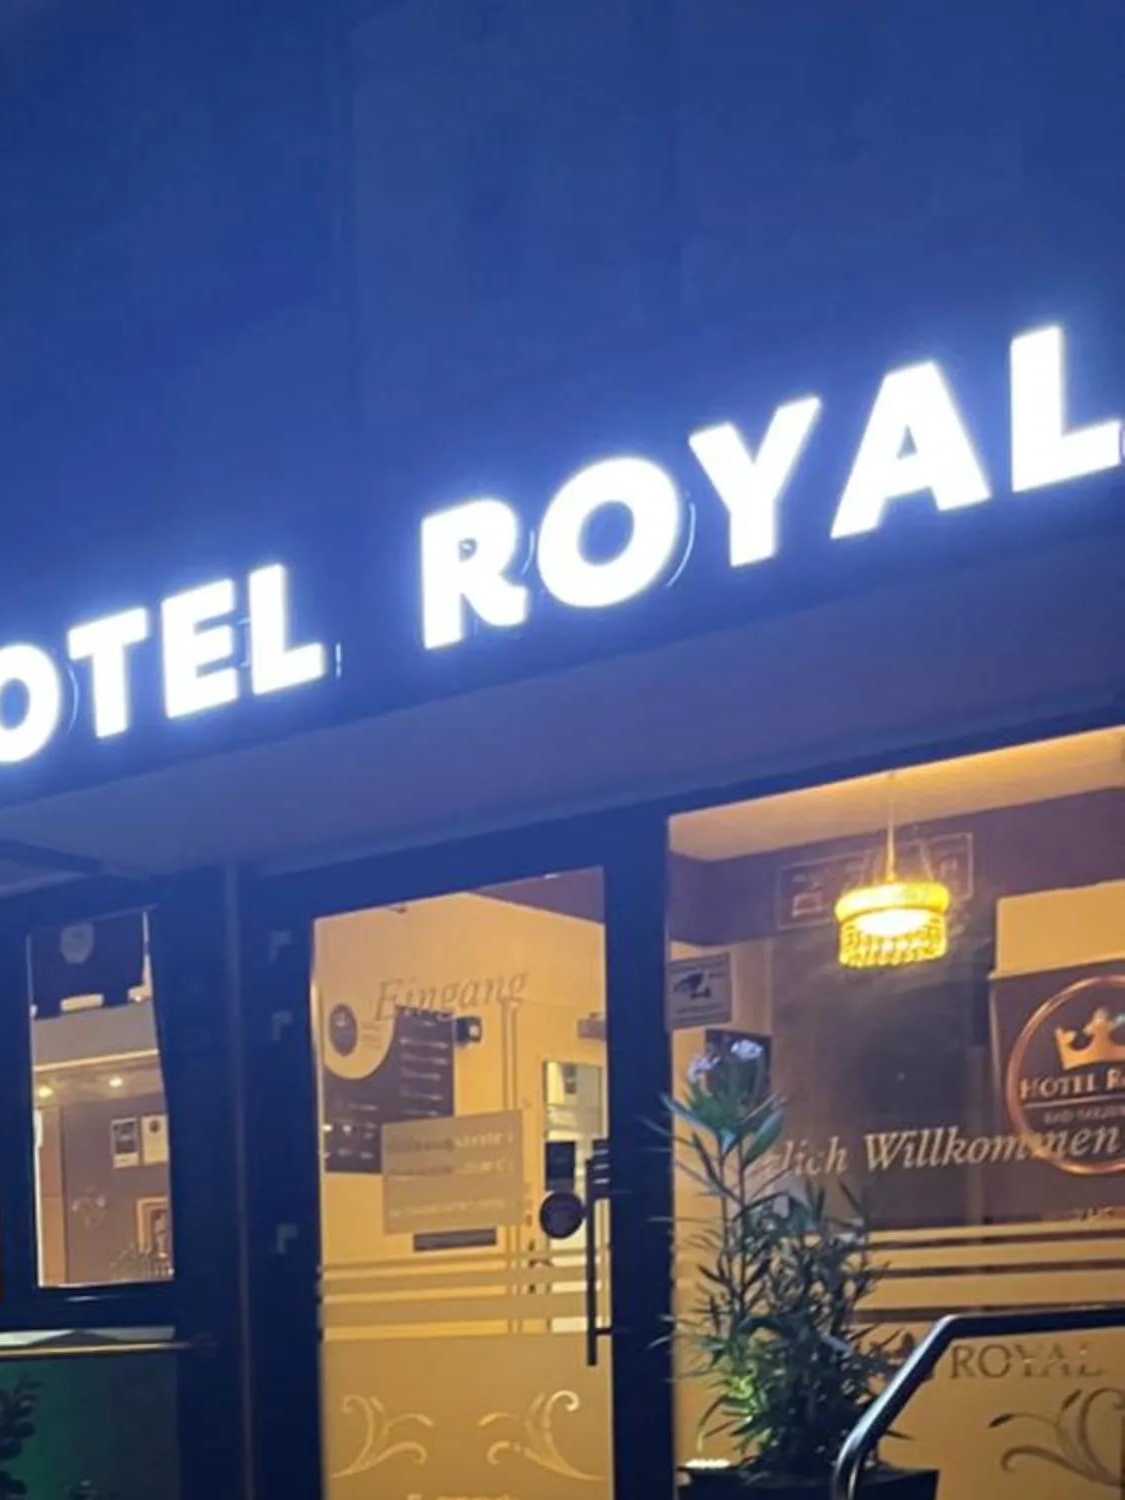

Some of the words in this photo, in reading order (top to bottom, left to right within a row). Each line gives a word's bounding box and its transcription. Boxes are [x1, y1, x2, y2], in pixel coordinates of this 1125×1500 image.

[421, 324, 1121, 650] ROYAL
[373, 971, 529, 1023] Eingang
[863, 1126, 1119, 1173] Willkommen
